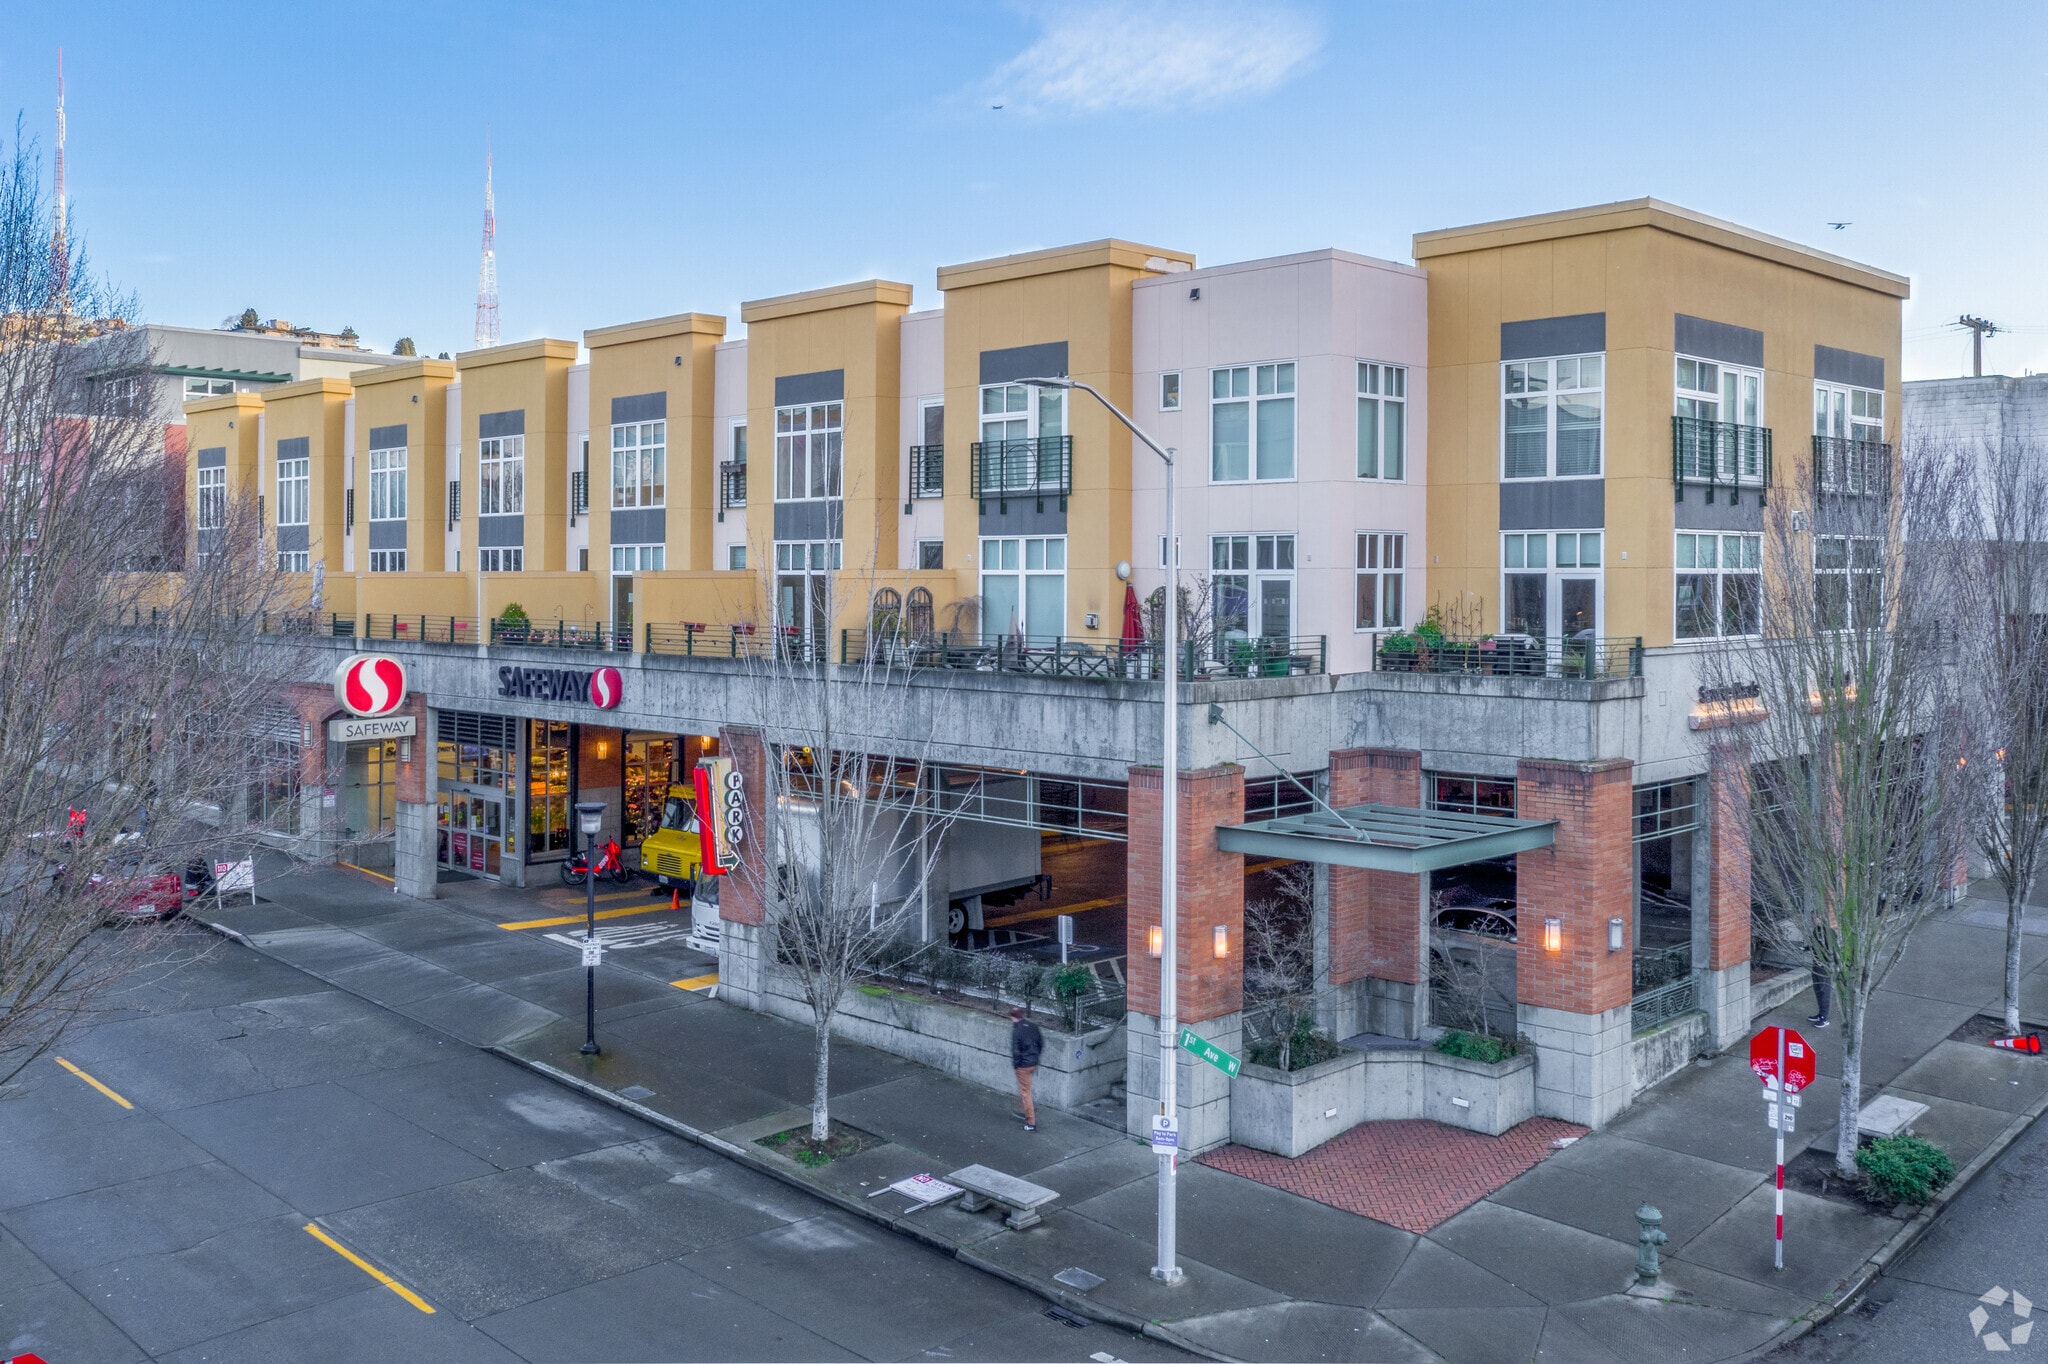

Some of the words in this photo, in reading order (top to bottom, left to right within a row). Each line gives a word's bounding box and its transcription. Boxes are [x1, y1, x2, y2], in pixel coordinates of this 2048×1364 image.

[498, 665, 594, 701] SAFEWAY
[345, 720, 409, 738] SAFEWAY
[730, 775, 741, 842] PARK
[1184, 1033, 1196, 1047] 1st
[1203, 1047, 1219, 1062] Ave
[1228, 1060, 1237, 1073] W
